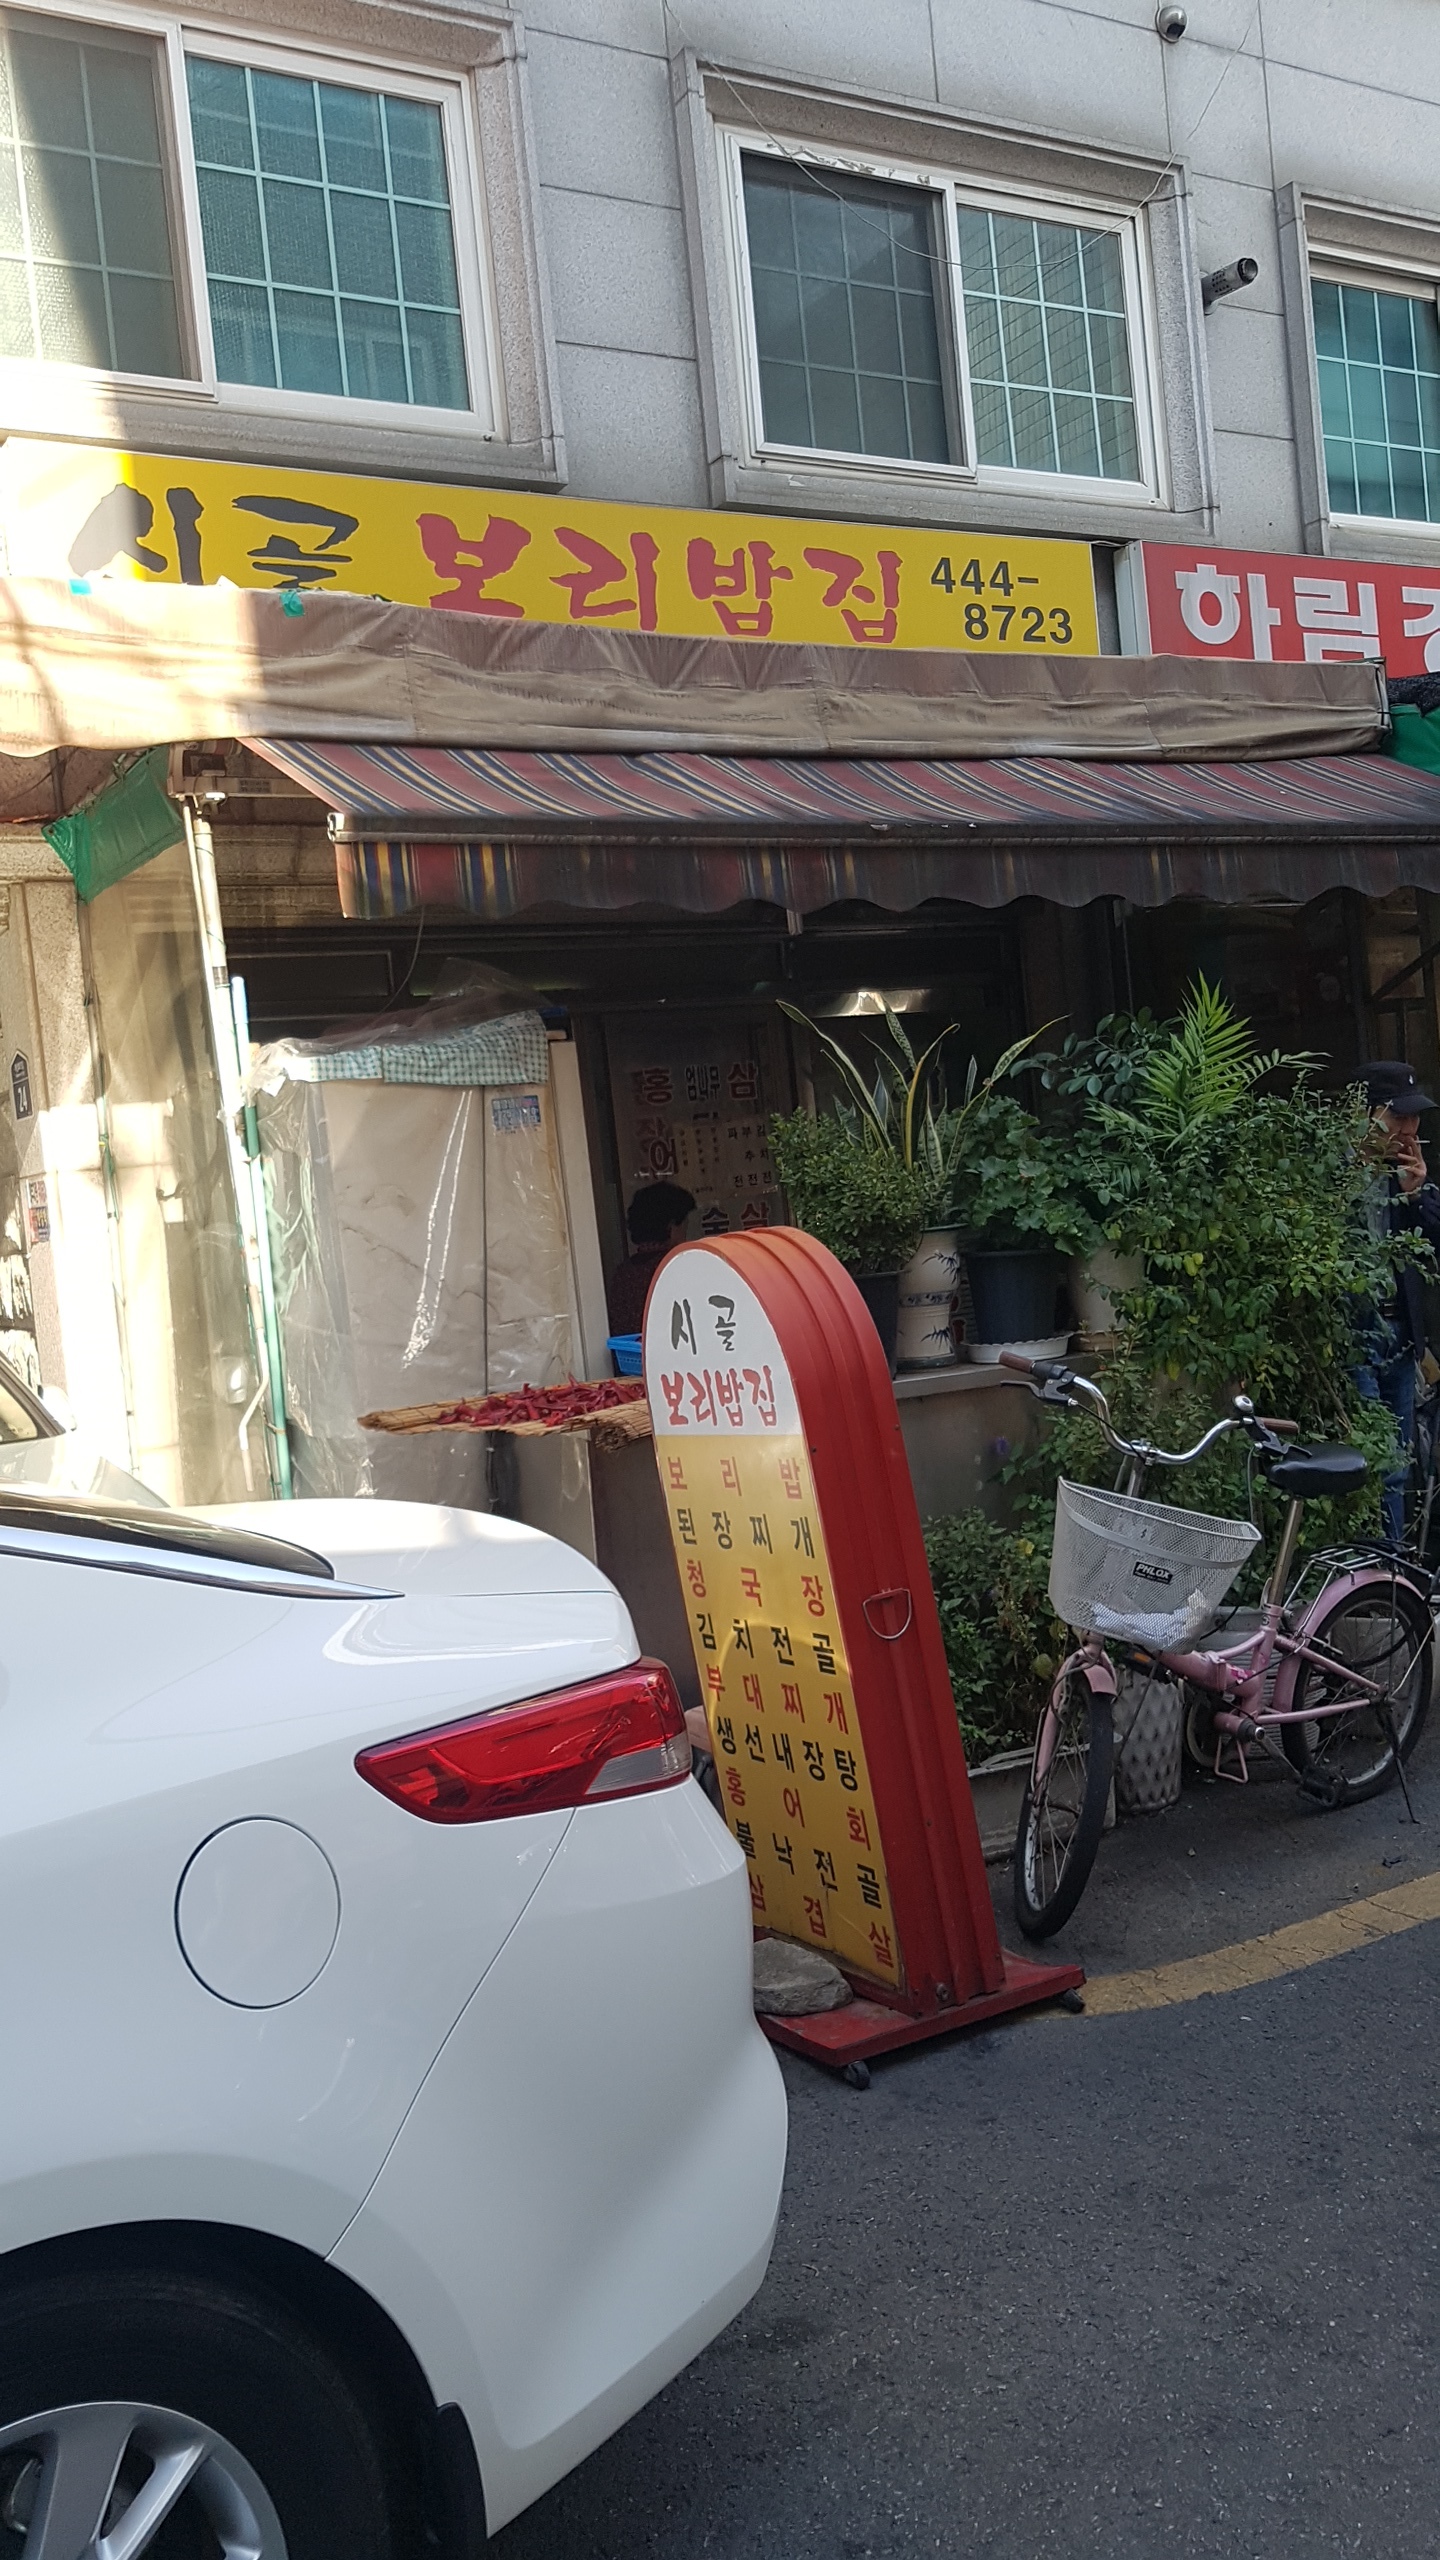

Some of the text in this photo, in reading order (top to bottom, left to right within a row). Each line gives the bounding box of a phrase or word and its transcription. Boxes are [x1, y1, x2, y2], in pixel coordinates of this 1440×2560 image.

[68, 482, 902, 644] 시골 보리밥집
[931, 557, 1039, 597] 444-
[964, 602, 1073, 644] 8723
[18, 1086, 27, 1112] 24
[671, 1295, 737, 1356] 시골
[661, 1365, 777, 1427] 보리밥집
[677, 1508, 816, 1559] 된장찌개
[1136, 1563, 1170, 1579] PHLOX
[697, 1613, 837, 1676] 김치전골
[706, 1664, 849, 1735] 부대찌개
[717, 1715, 859, 1792] 생선내장탕
